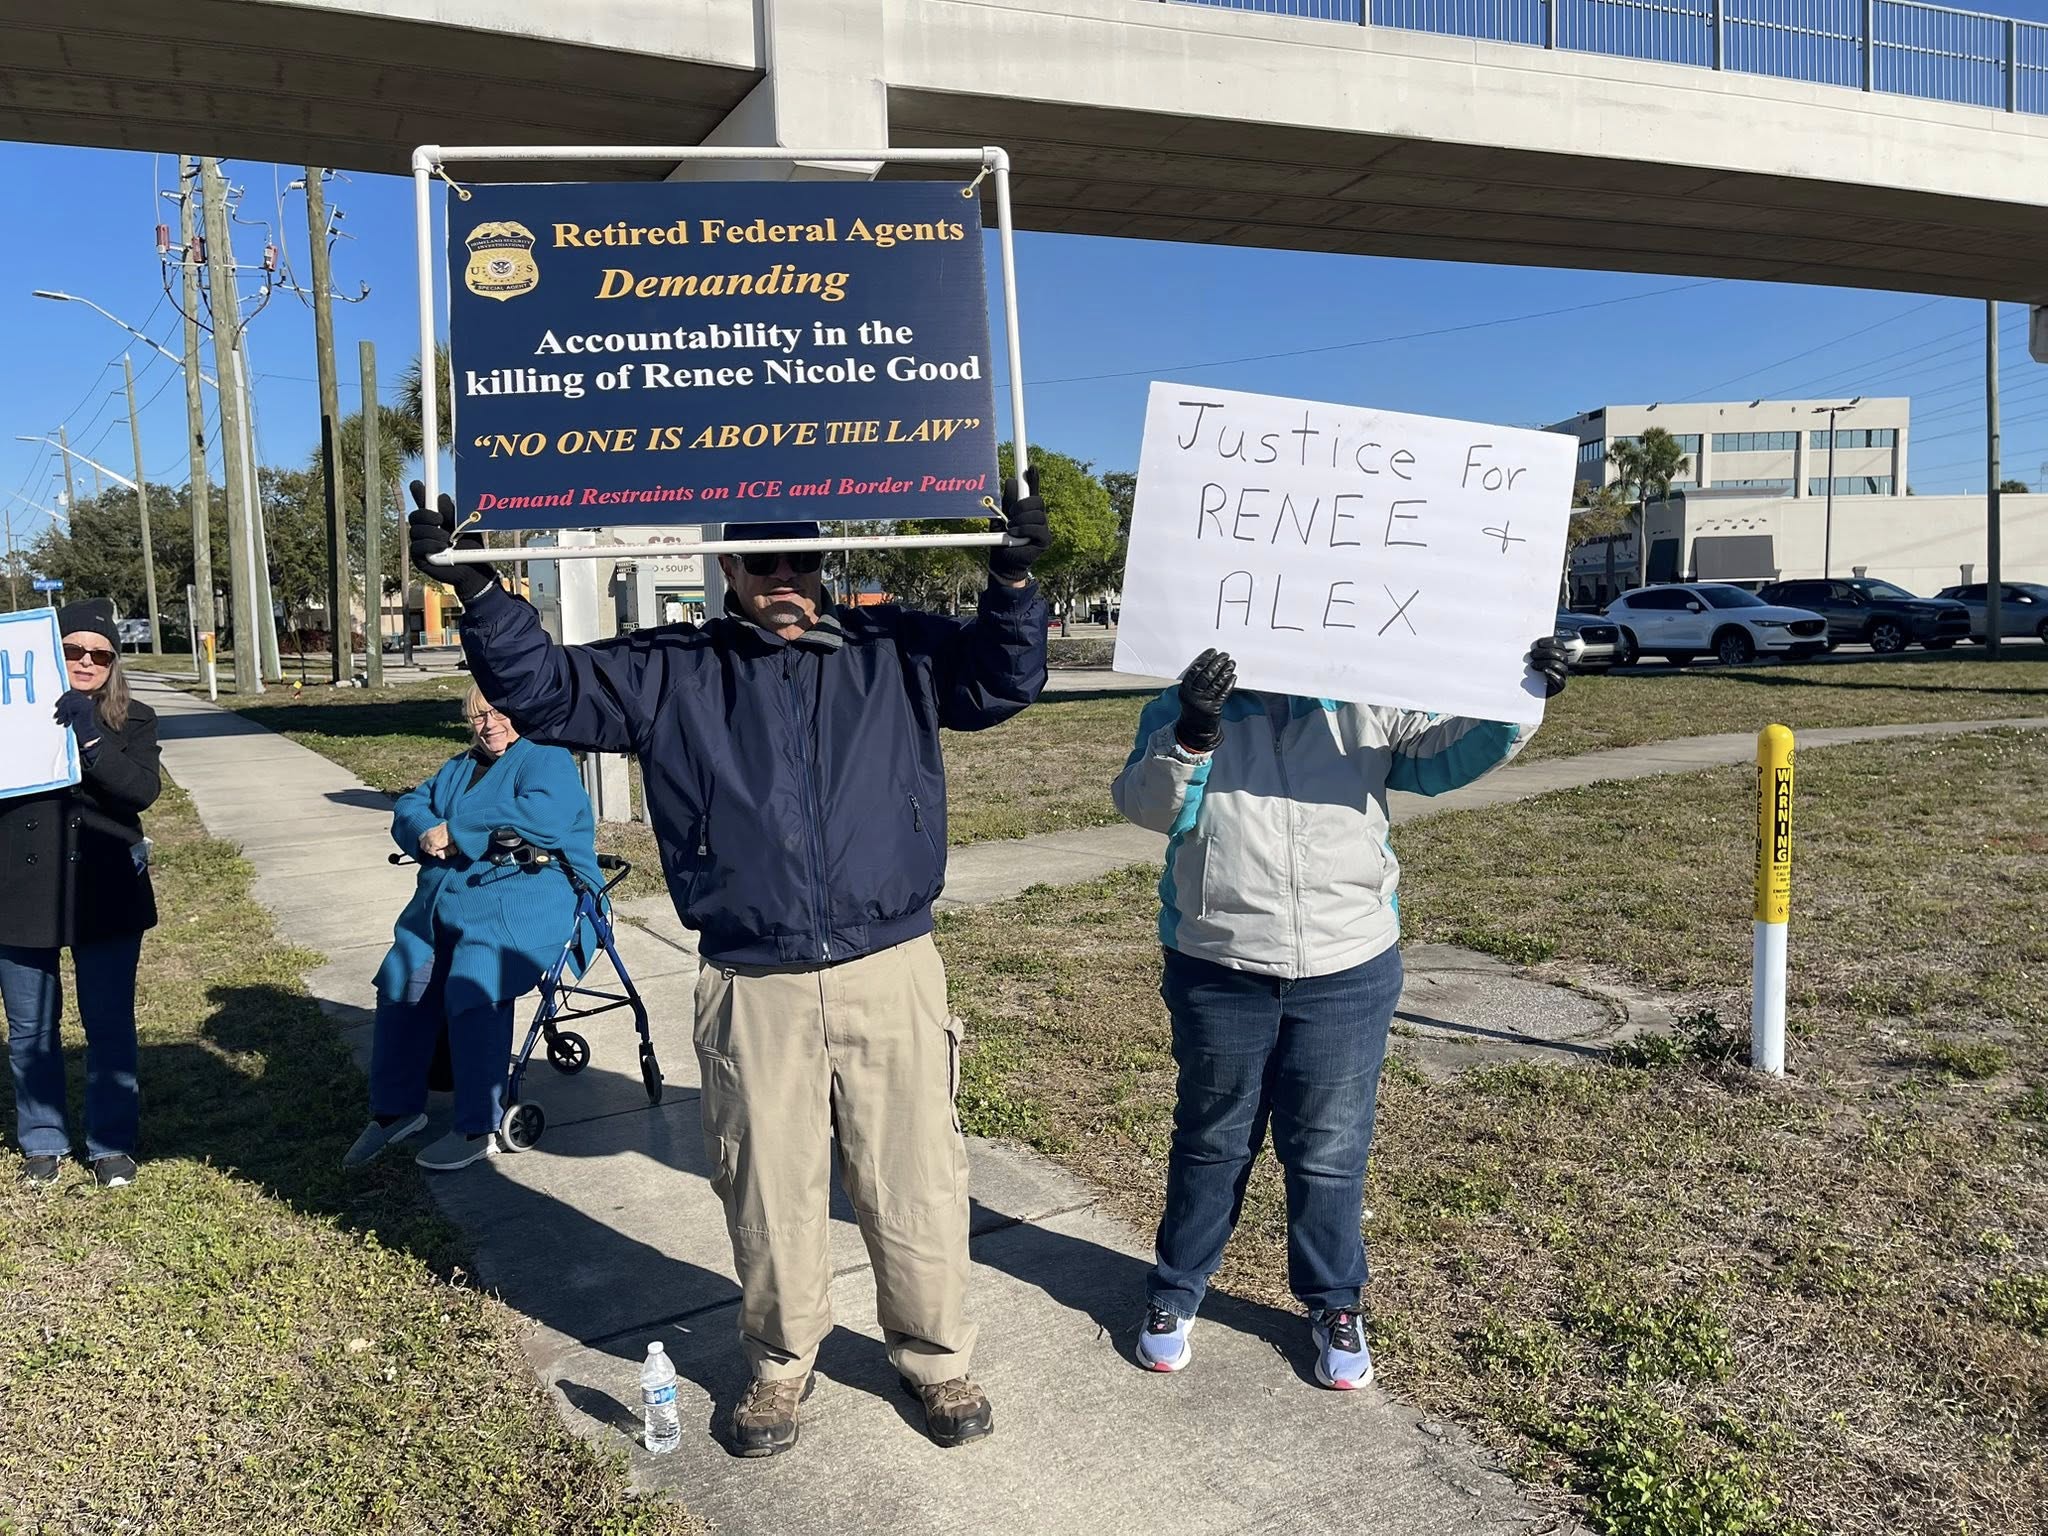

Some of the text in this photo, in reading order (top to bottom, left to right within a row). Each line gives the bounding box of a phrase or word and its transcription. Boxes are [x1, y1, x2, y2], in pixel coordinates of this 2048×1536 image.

[552, 217, 965, 248] Retired Federal Agents
[470, 265, 533, 275] U S
[594, 264, 850, 302] Demanding
[533, 320, 913, 355] Accountability in the
[465, 355, 982, 399] killing of Renee Nicole Good
[556, 428, 637, 455] ONE
[645, 425, 684, 451] IS
[689, 422, 819, 449] ABOVE
[826, 420, 879, 445] THE
[1177, 400, 1527, 491] Justice For
[476, 473, 986, 511] Demand Restraints on ICE and Border Patrol
[1197, 482, 1428, 548] RENEE
[665, 564, 694, 573] SOUPS
[1216, 570, 1420, 637] ALEX
[0, 649, 35, 705] H
[1776, 768, 1790, 862] WARNING
